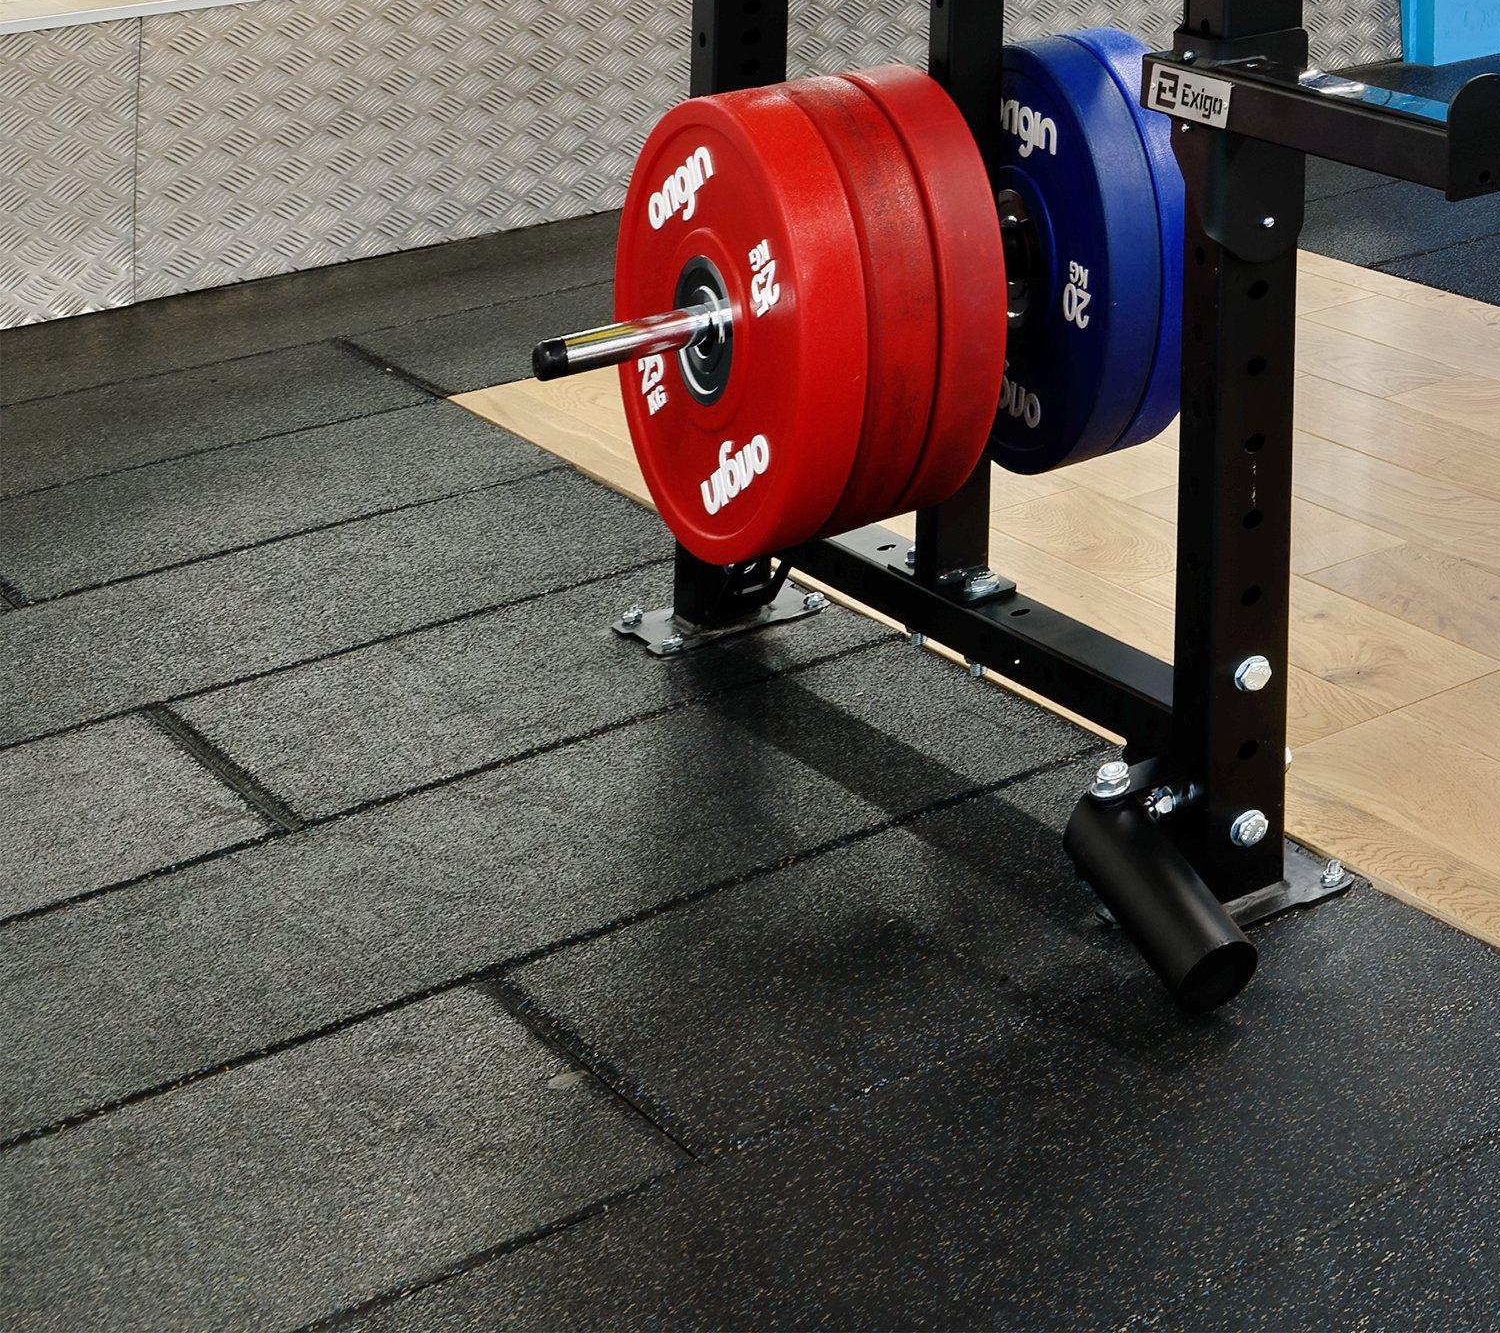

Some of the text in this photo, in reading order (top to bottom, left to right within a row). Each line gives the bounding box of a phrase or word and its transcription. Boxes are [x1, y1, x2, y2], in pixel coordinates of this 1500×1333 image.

[1181, 86, 1223, 117] Exigo
[648, 145, 714, 230] origin
[748, 238, 773, 273] KG
[1068, 260, 1088, 290] KG
[751, 273, 781, 318] 25
[1063, 284, 1091, 329] 20
[700, 434, 770, 515] origin
